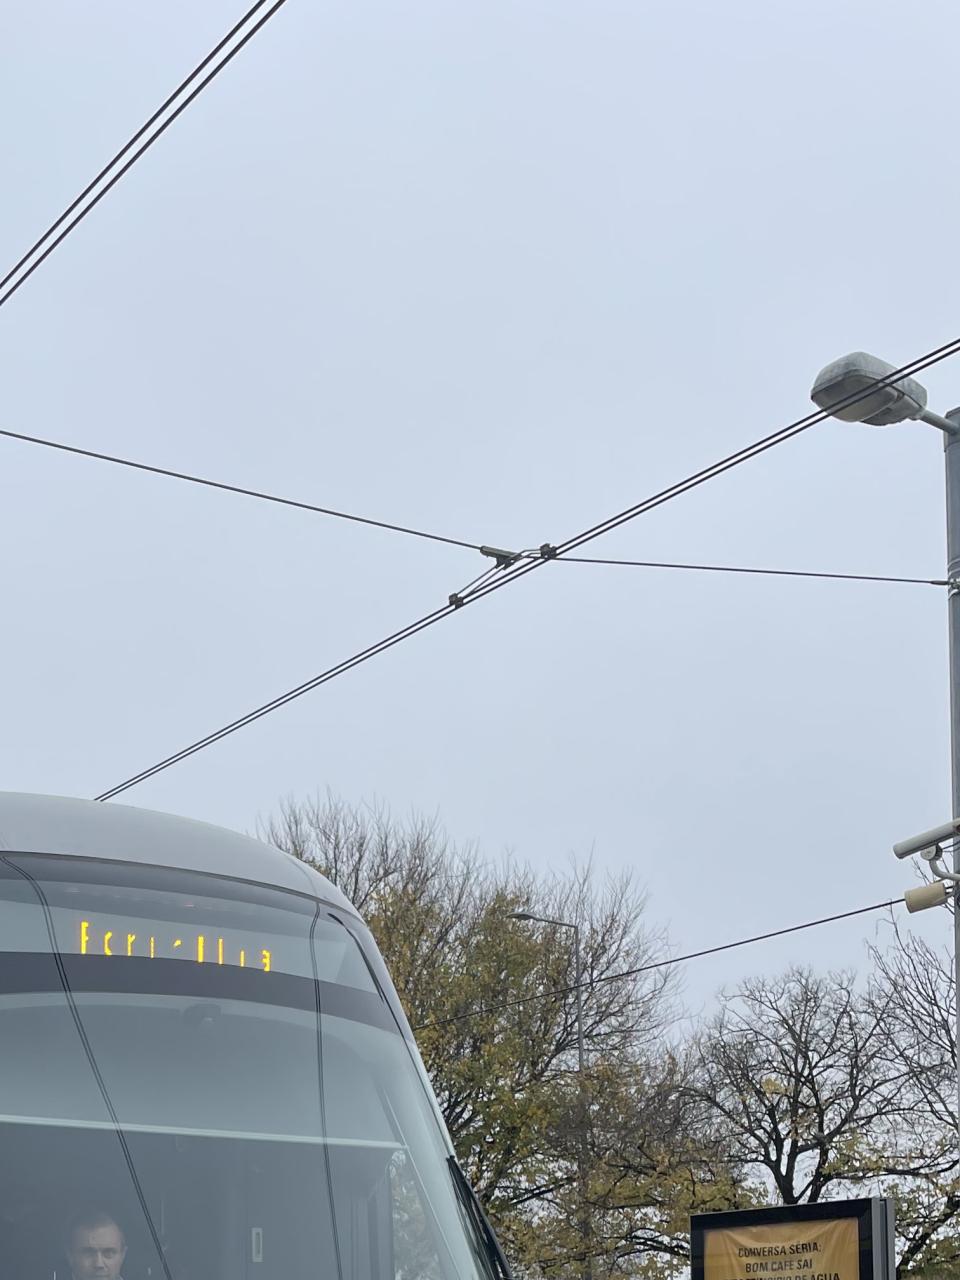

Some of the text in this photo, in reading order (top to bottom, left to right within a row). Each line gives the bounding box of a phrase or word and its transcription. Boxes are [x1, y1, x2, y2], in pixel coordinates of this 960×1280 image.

[738, 1246, 787, 1258] CONVERSA
[745, 1262, 768, 1273] BOM
[796, 1259, 813, 1270] SAI
